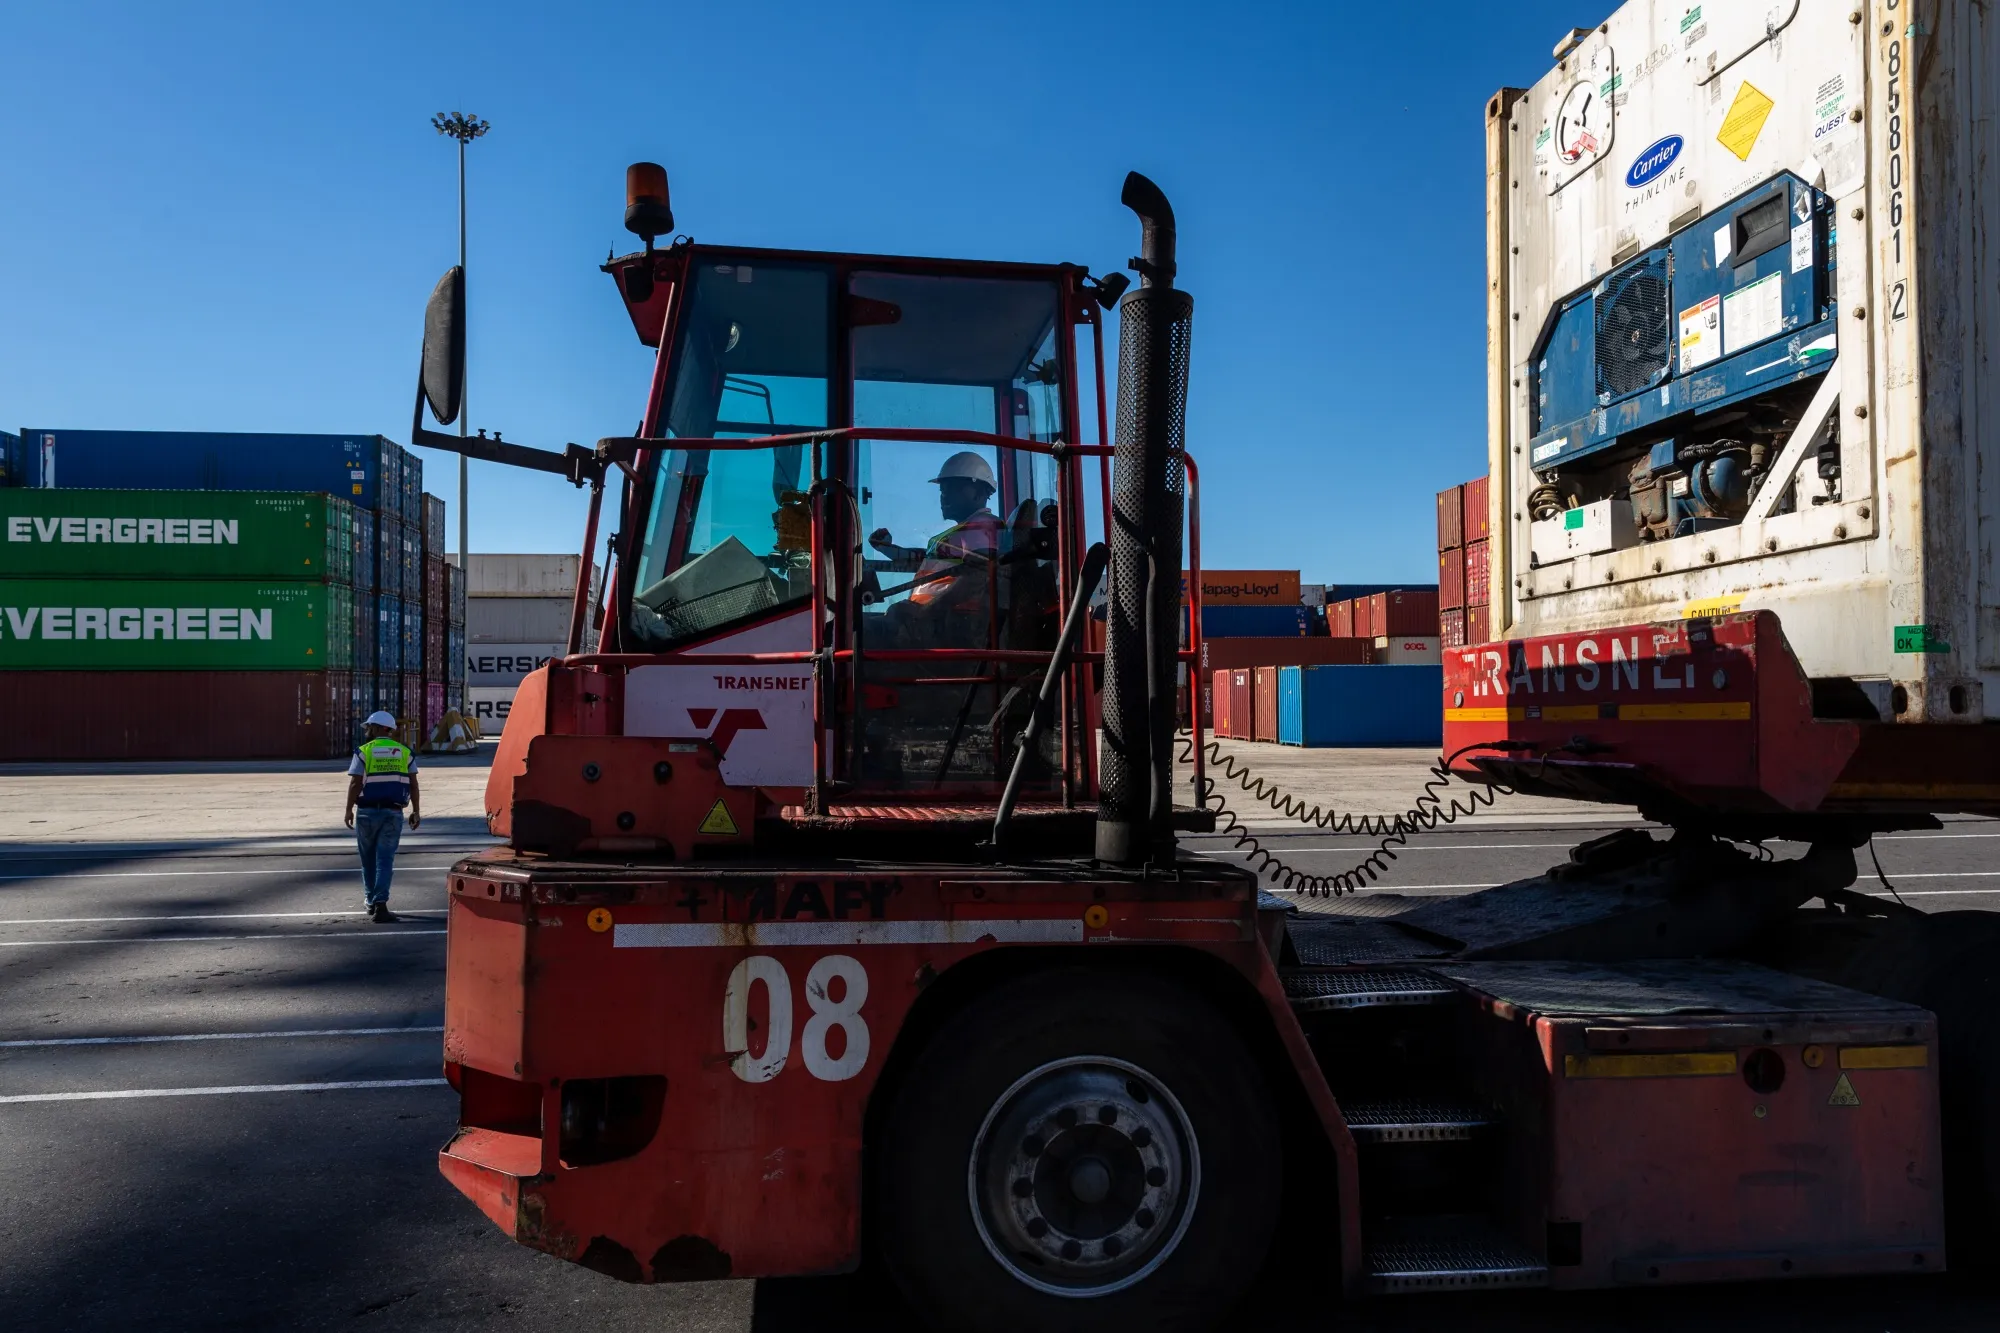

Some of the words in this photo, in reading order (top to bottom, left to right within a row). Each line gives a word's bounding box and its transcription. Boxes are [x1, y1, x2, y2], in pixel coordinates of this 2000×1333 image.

[1816, 93, 1845, 116] ECONOMY
[1821, 104, 1839, 120] MODE
[1815, 112, 1847, 138] QUEST
[1633, 142, 1677, 180] Carrier
[1625, 166, 1685, 214] THINLINE
[1891, 282, 1905, 321] 2
[8, 516, 239, 544] EVERGREEN
[1201, 583, 1278, 597] Hapag-Lloyd
[1898, 638, 1912, 650] OK
[713, 676, 811, 690] TRANSNET
[723, 954, 870, 1083] 08
